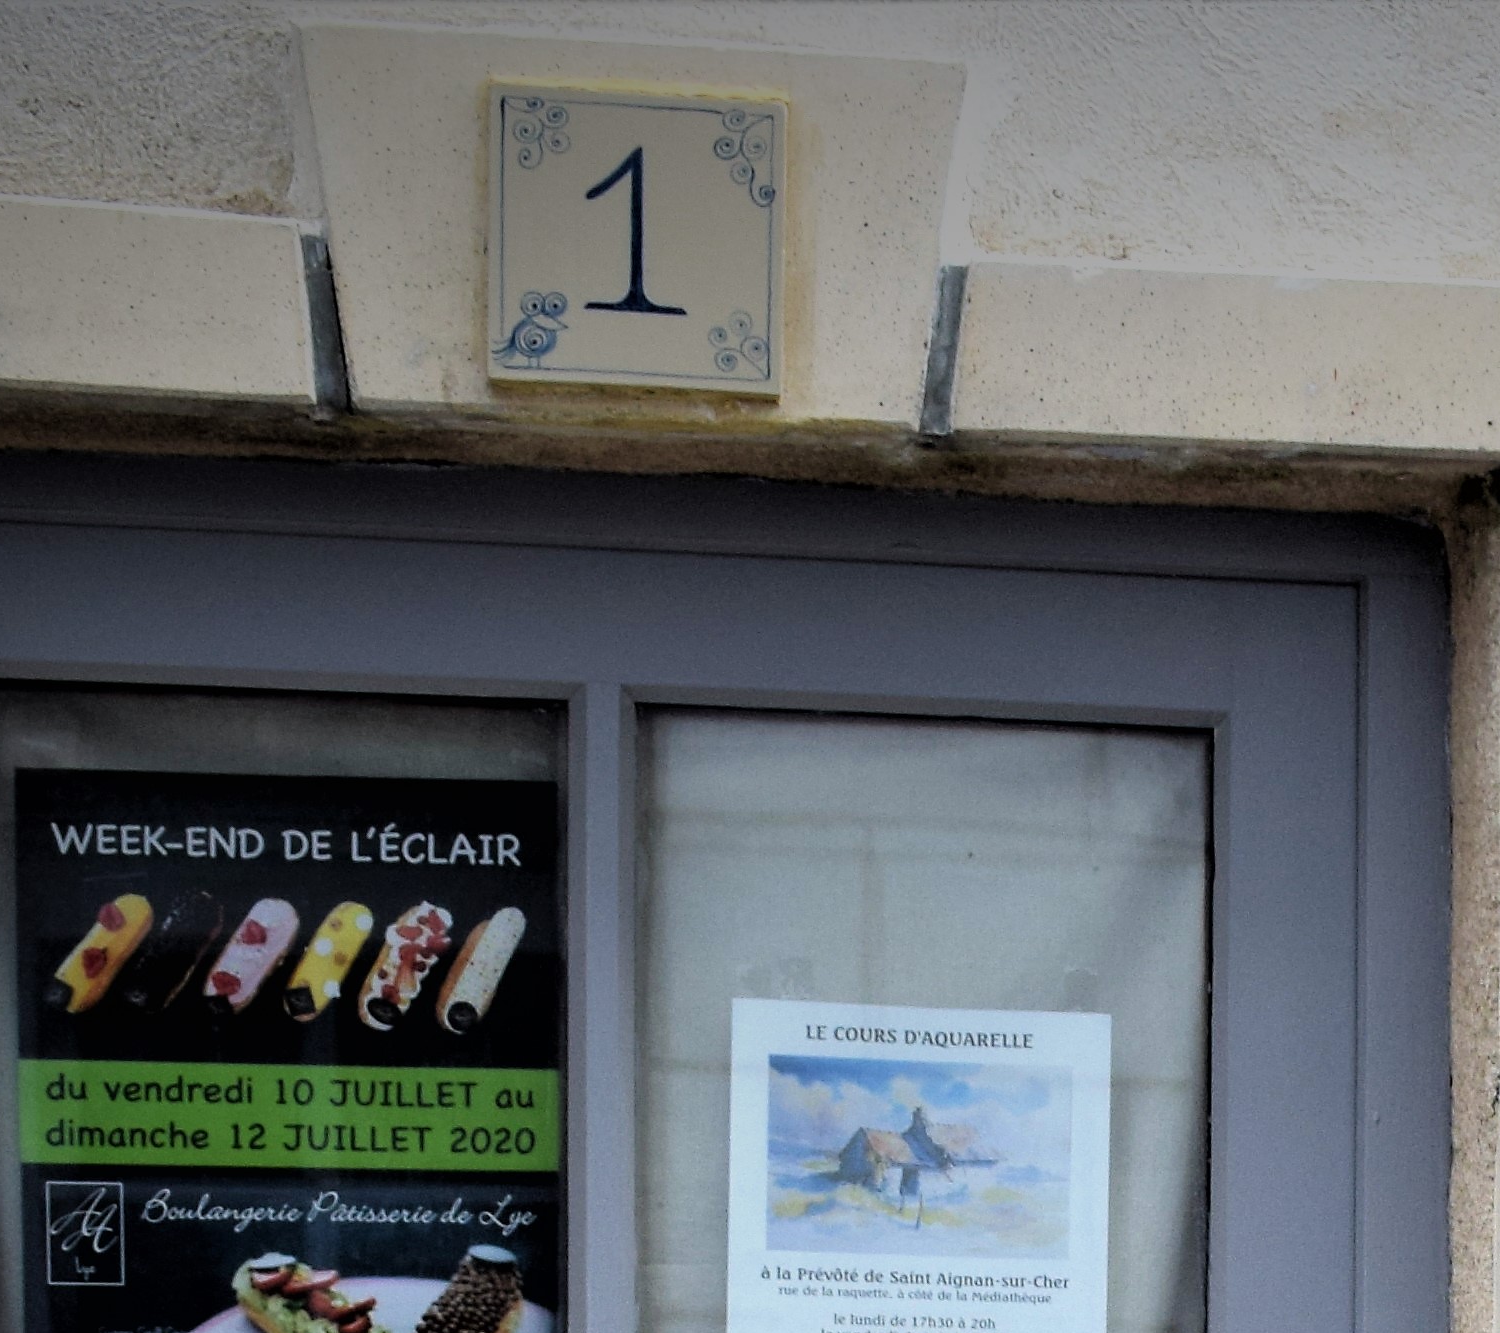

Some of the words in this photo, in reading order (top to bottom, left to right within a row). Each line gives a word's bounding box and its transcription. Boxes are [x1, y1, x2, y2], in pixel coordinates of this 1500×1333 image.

[584, 146, 687, 316] 1
[51, 823, 264, 859] WEEK-END
[282, 829, 332, 861] DE
[351, 822, 521, 866] L'ÉCLAIR
[806, 1025, 826, 1040] LE
[834, 1026, 896, 1044] COURS
[905, 1029, 1032, 1049] D'AQUARELLE
[46, 1073, 88, 1101] du
[104, 1075, 252, 1105] vendredi
[276, 1078, 314, 1106] 10
[330, 1078, 478, 1109] JUILLET
[495, 1088, 534, 1110] au
[46, 1118, 210, 1150] dimanche
[231, 1122, 266, 1150] 12
[283, 1123, 432, 1153] JUILLET
[450, 1127, 535, 1155] 2020
[141, 1187, 302, 1233] Boulangerie
[307, 1191, 437, 1224] Pâtisserie
[440, 1196, 473, 1224] de
[479, 1194, 536, 1237] Lye
[761, 1266, 770, 1280] à
[777, 1266, 791, 1280] la
[797, 1267, 858, 1282] Prévôté
[864, 1270, 883, 1283] de
[890, 1271, 931, 1285] Saint
[937, 1272, 1069, 1289] Aignan-sur-Cher
[834, 1313, 845, 1325] le
[851, 1313, 885, 1327] lundi
[890, 1315, 906, 1327] de
[913, 1316, 953, 1329] 17h30
[958, 1317, 965, 1329] à
[971, 1317, 995, 1330] 20h
